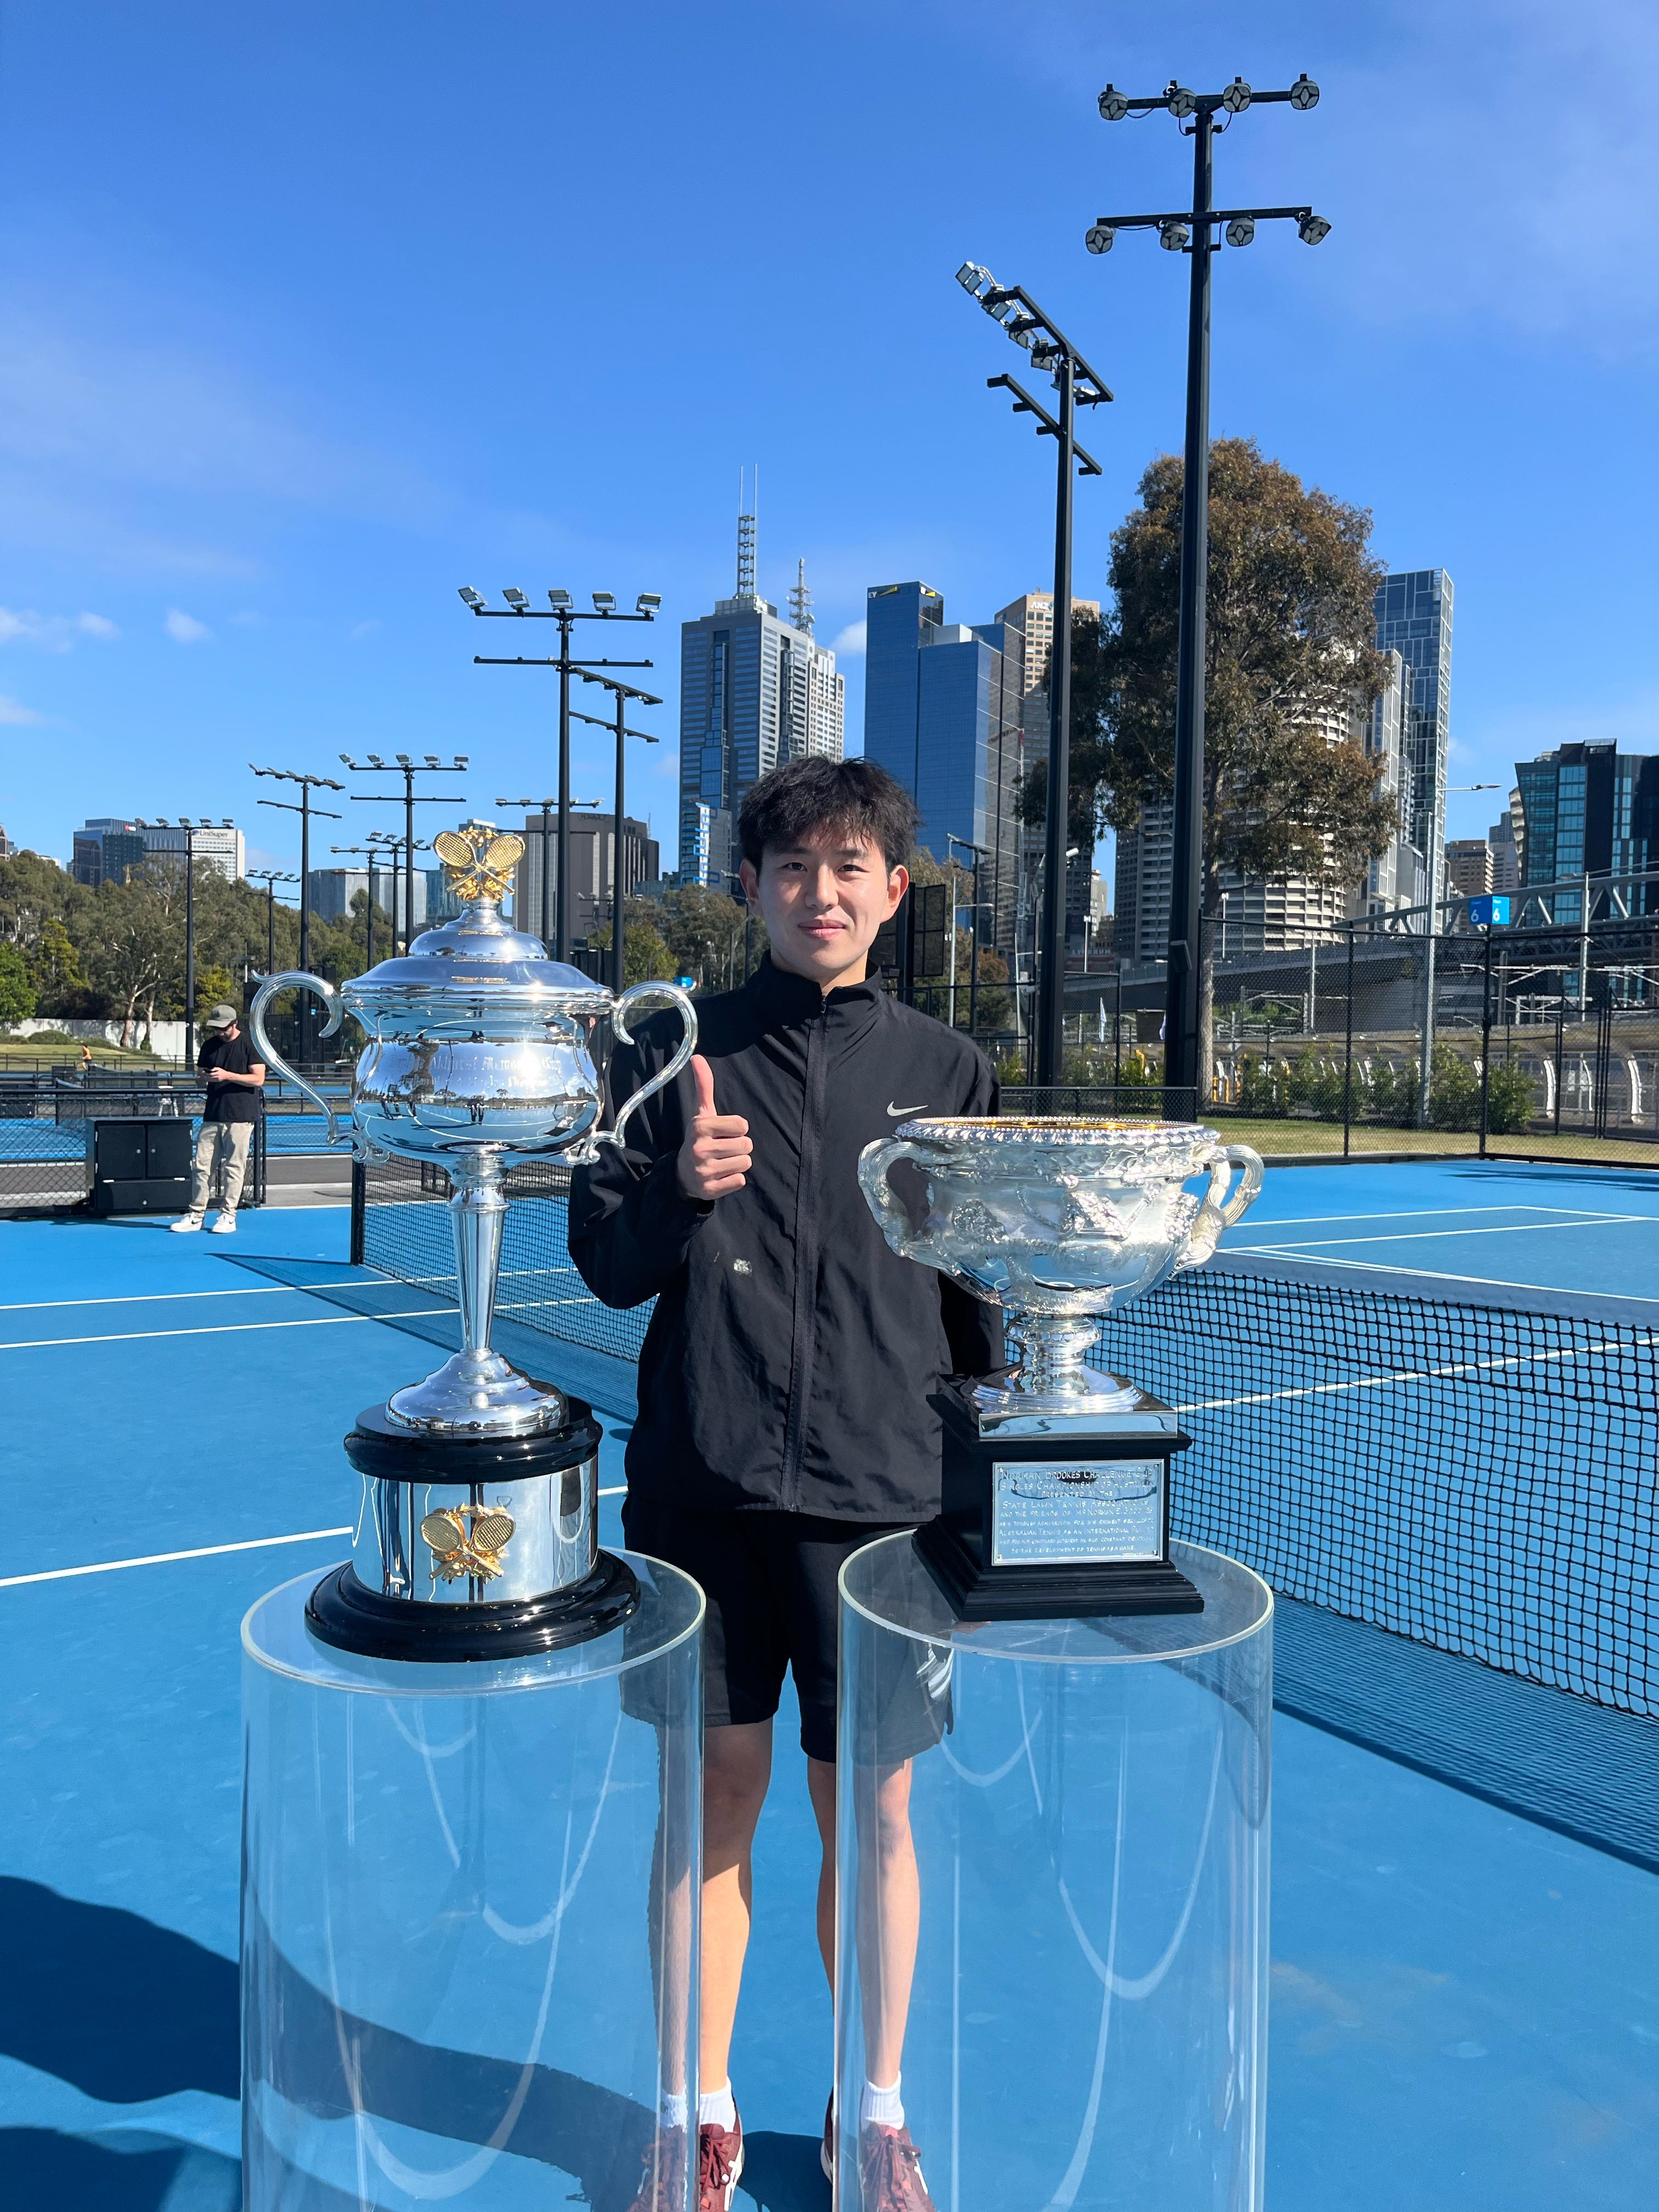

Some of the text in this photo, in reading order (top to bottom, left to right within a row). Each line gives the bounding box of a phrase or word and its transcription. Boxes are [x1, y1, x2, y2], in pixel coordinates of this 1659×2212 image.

[1030, 601, 1048, 610] ANZ
[200, 830, 228, 838] UniSuper
[1470, 909, 1479, 922] 6
[1493, 908, 1500, 922] 6
[1002, 1470, 1041, 1480] NORMAN
[1045, 1469, 1081, 1480] BROOKES
[1084, 1468, 1133, 1480] CHALLENGE
[1001, 1482, 1034, 1491] SINGLES
[1002, 1500, 1027, 1509] STATE
[1056, 1499, 1087, 1508] TENNIS
